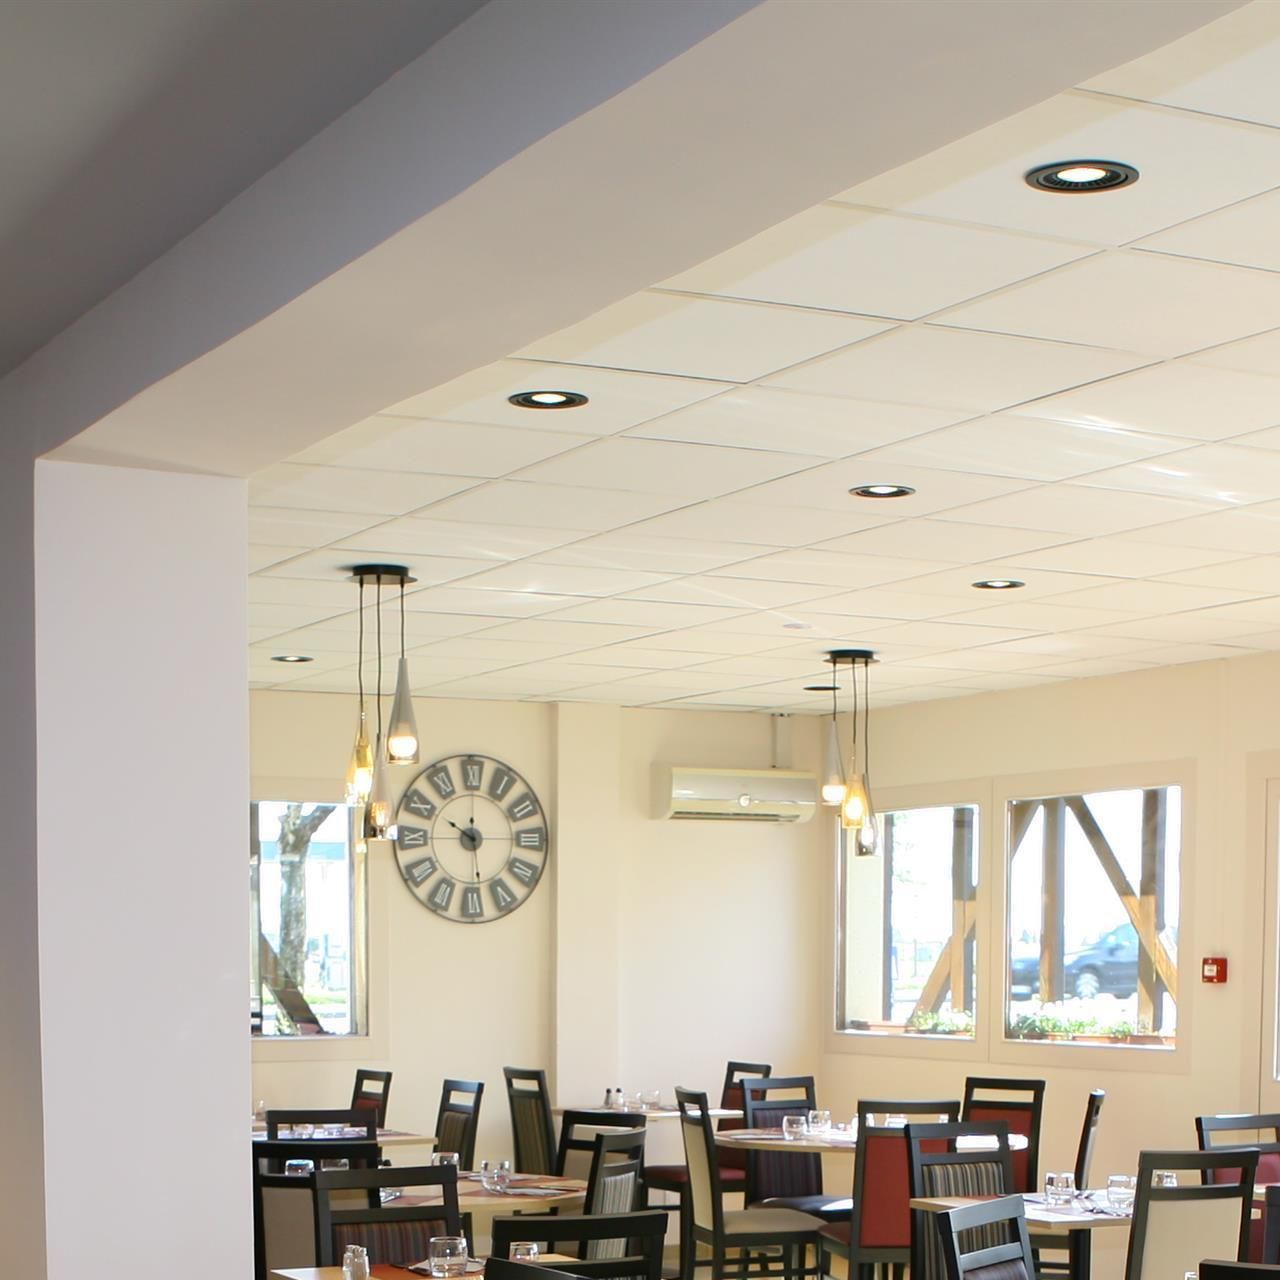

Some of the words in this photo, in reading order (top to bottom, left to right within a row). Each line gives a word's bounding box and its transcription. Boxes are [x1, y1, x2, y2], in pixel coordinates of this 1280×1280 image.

[433, 772, 453, 795] XI
[467, 765, 480, 786] XII
[496, 775, 509, 795] I
[410, 796, 431, 816] X
[513, 801, 533, 817] II
[404, 830, 424, 845] IX
[520, 833, 539, 846] III
[513, 862, 532, 881] IV
[467, 893, 480, 913] VI
[496, 886, 512, 907] V
